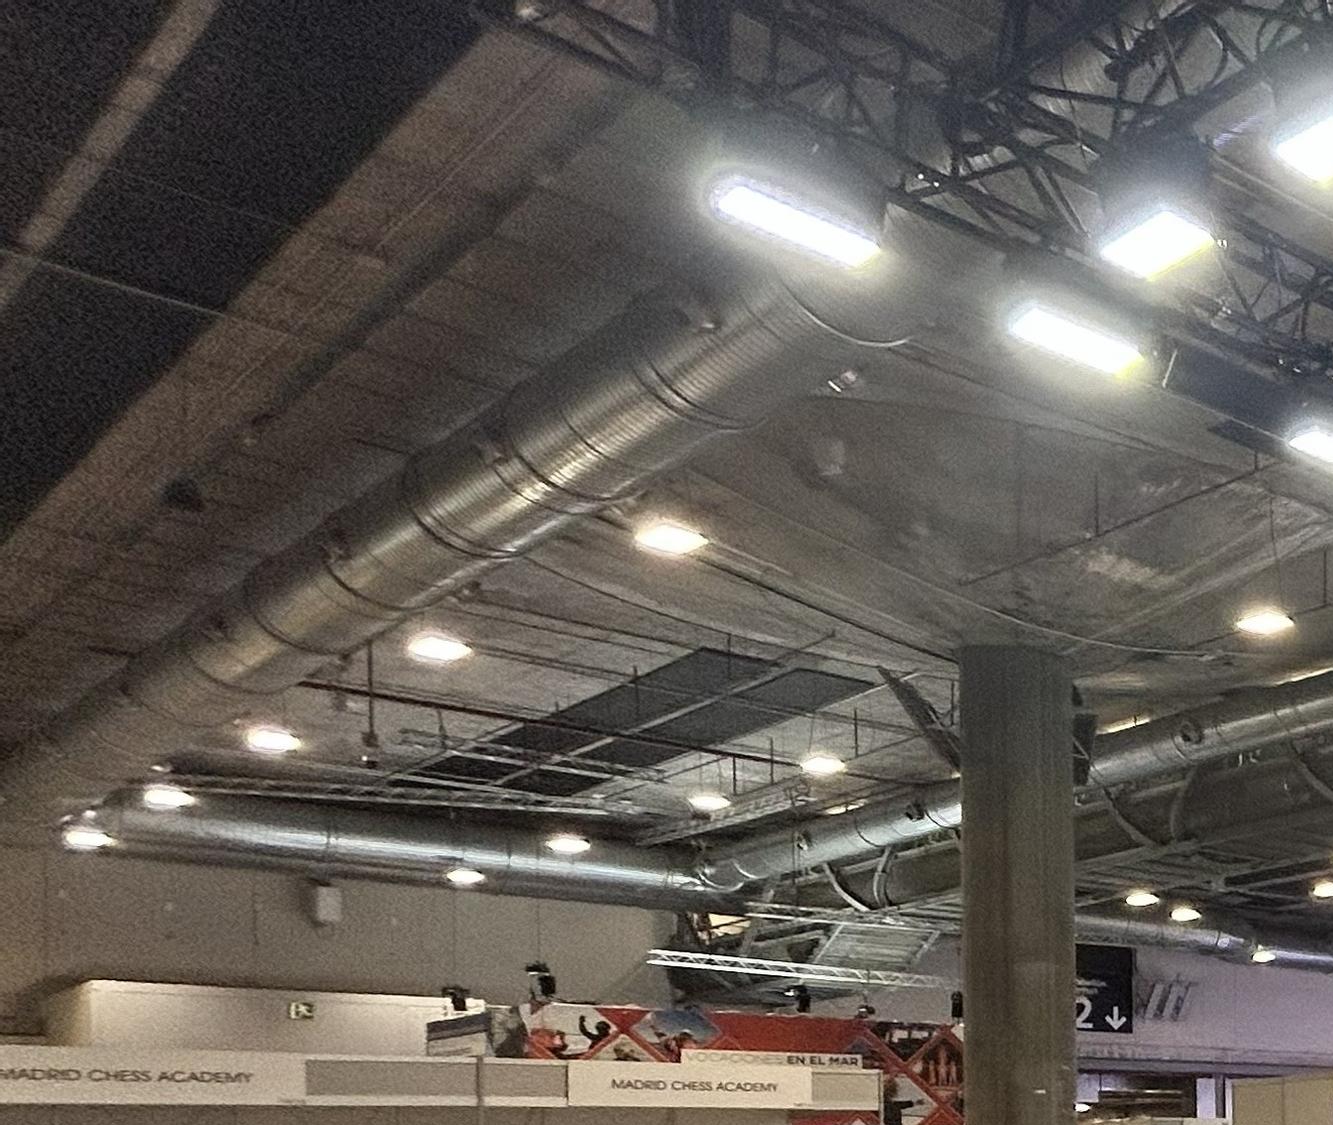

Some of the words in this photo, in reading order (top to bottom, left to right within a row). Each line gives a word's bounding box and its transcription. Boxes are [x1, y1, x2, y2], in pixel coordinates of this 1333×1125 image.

[787, 1055, 806, 1064] EN
[810, 1056, 826, 1065] EL
[829, 1056, 859, 1067] MAR
[87, 1069, 152, 1082] CHESS
[157, 1071, 254, 1083] ACADEMY
[611, 1078, 667, 1091] MADRID
[671, 1080, 713, 1092] CHESS
[716, 1081, 779, 1093] ACADEMY
